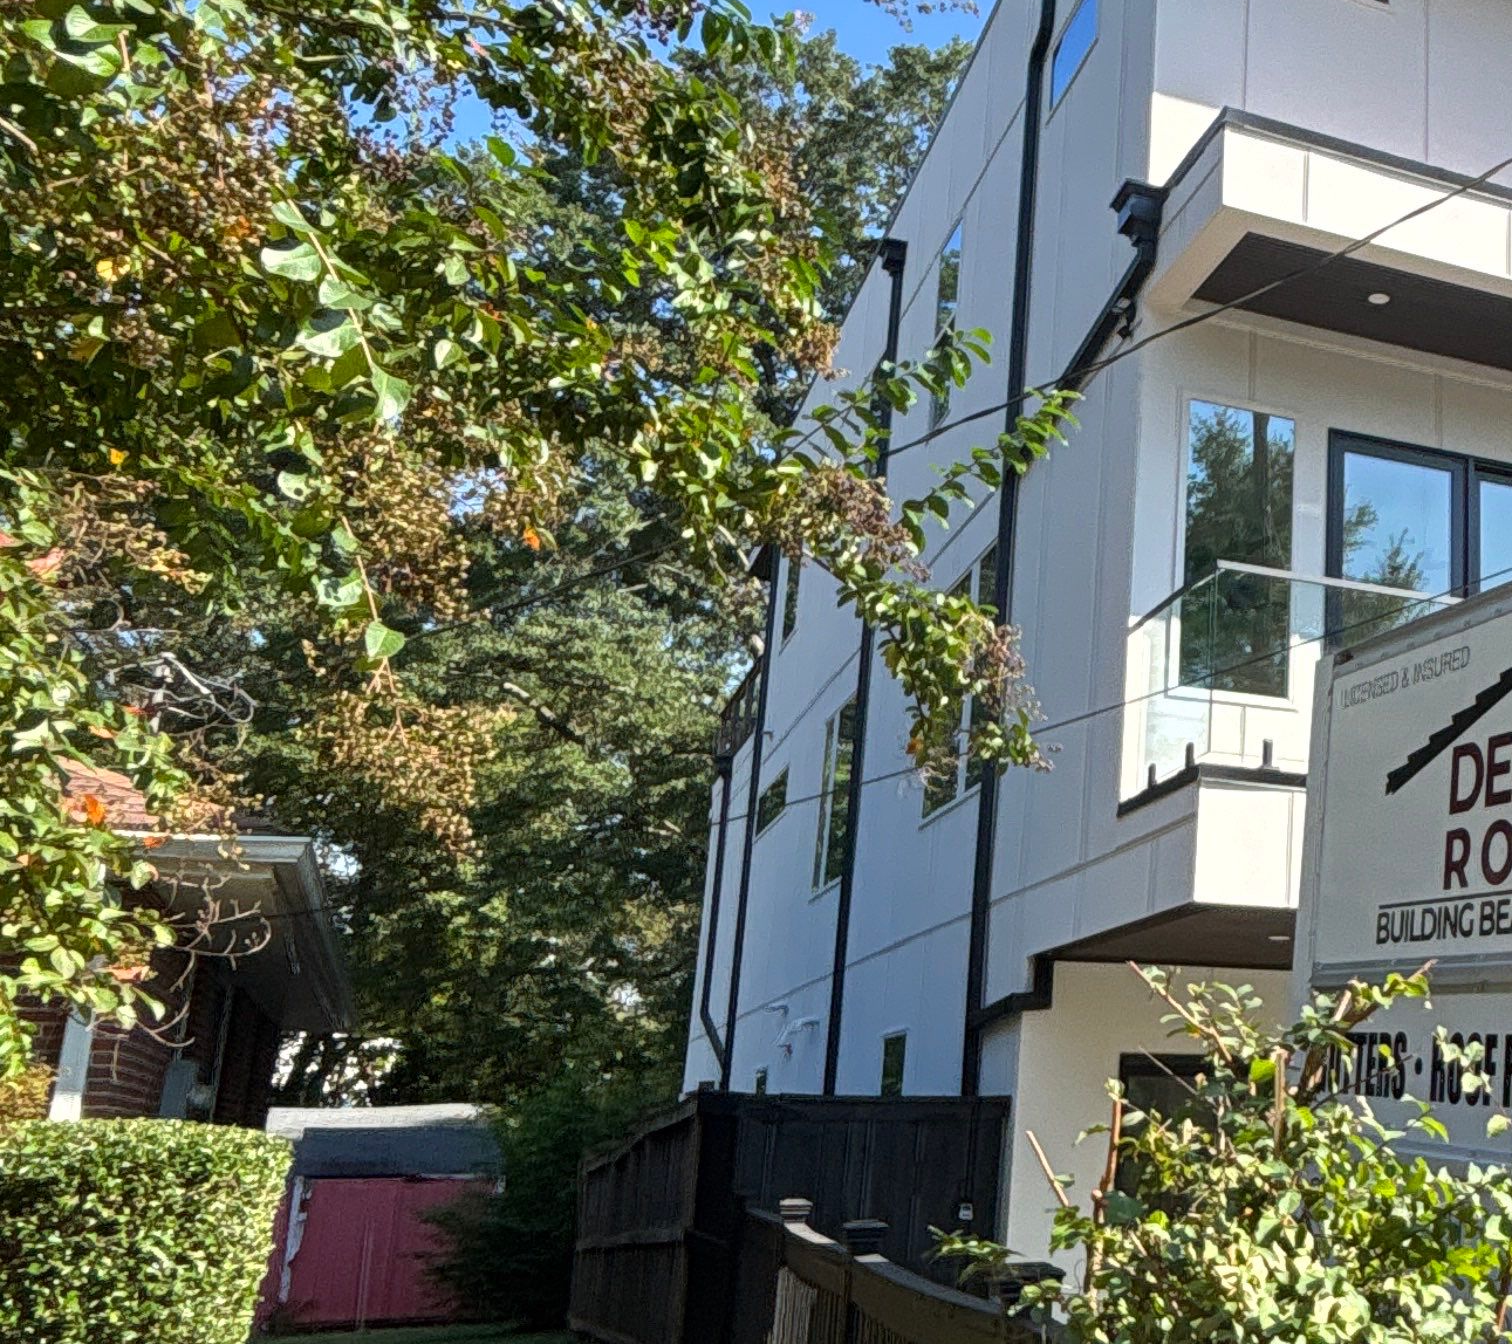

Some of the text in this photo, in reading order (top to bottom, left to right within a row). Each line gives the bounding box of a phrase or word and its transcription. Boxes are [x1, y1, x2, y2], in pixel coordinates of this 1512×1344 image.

[1412, 645, 1471, 684] INSURED
[1375, 902, 1475, 946] BUILDING
[1310, 1031, 1408, 1101] UTERS
